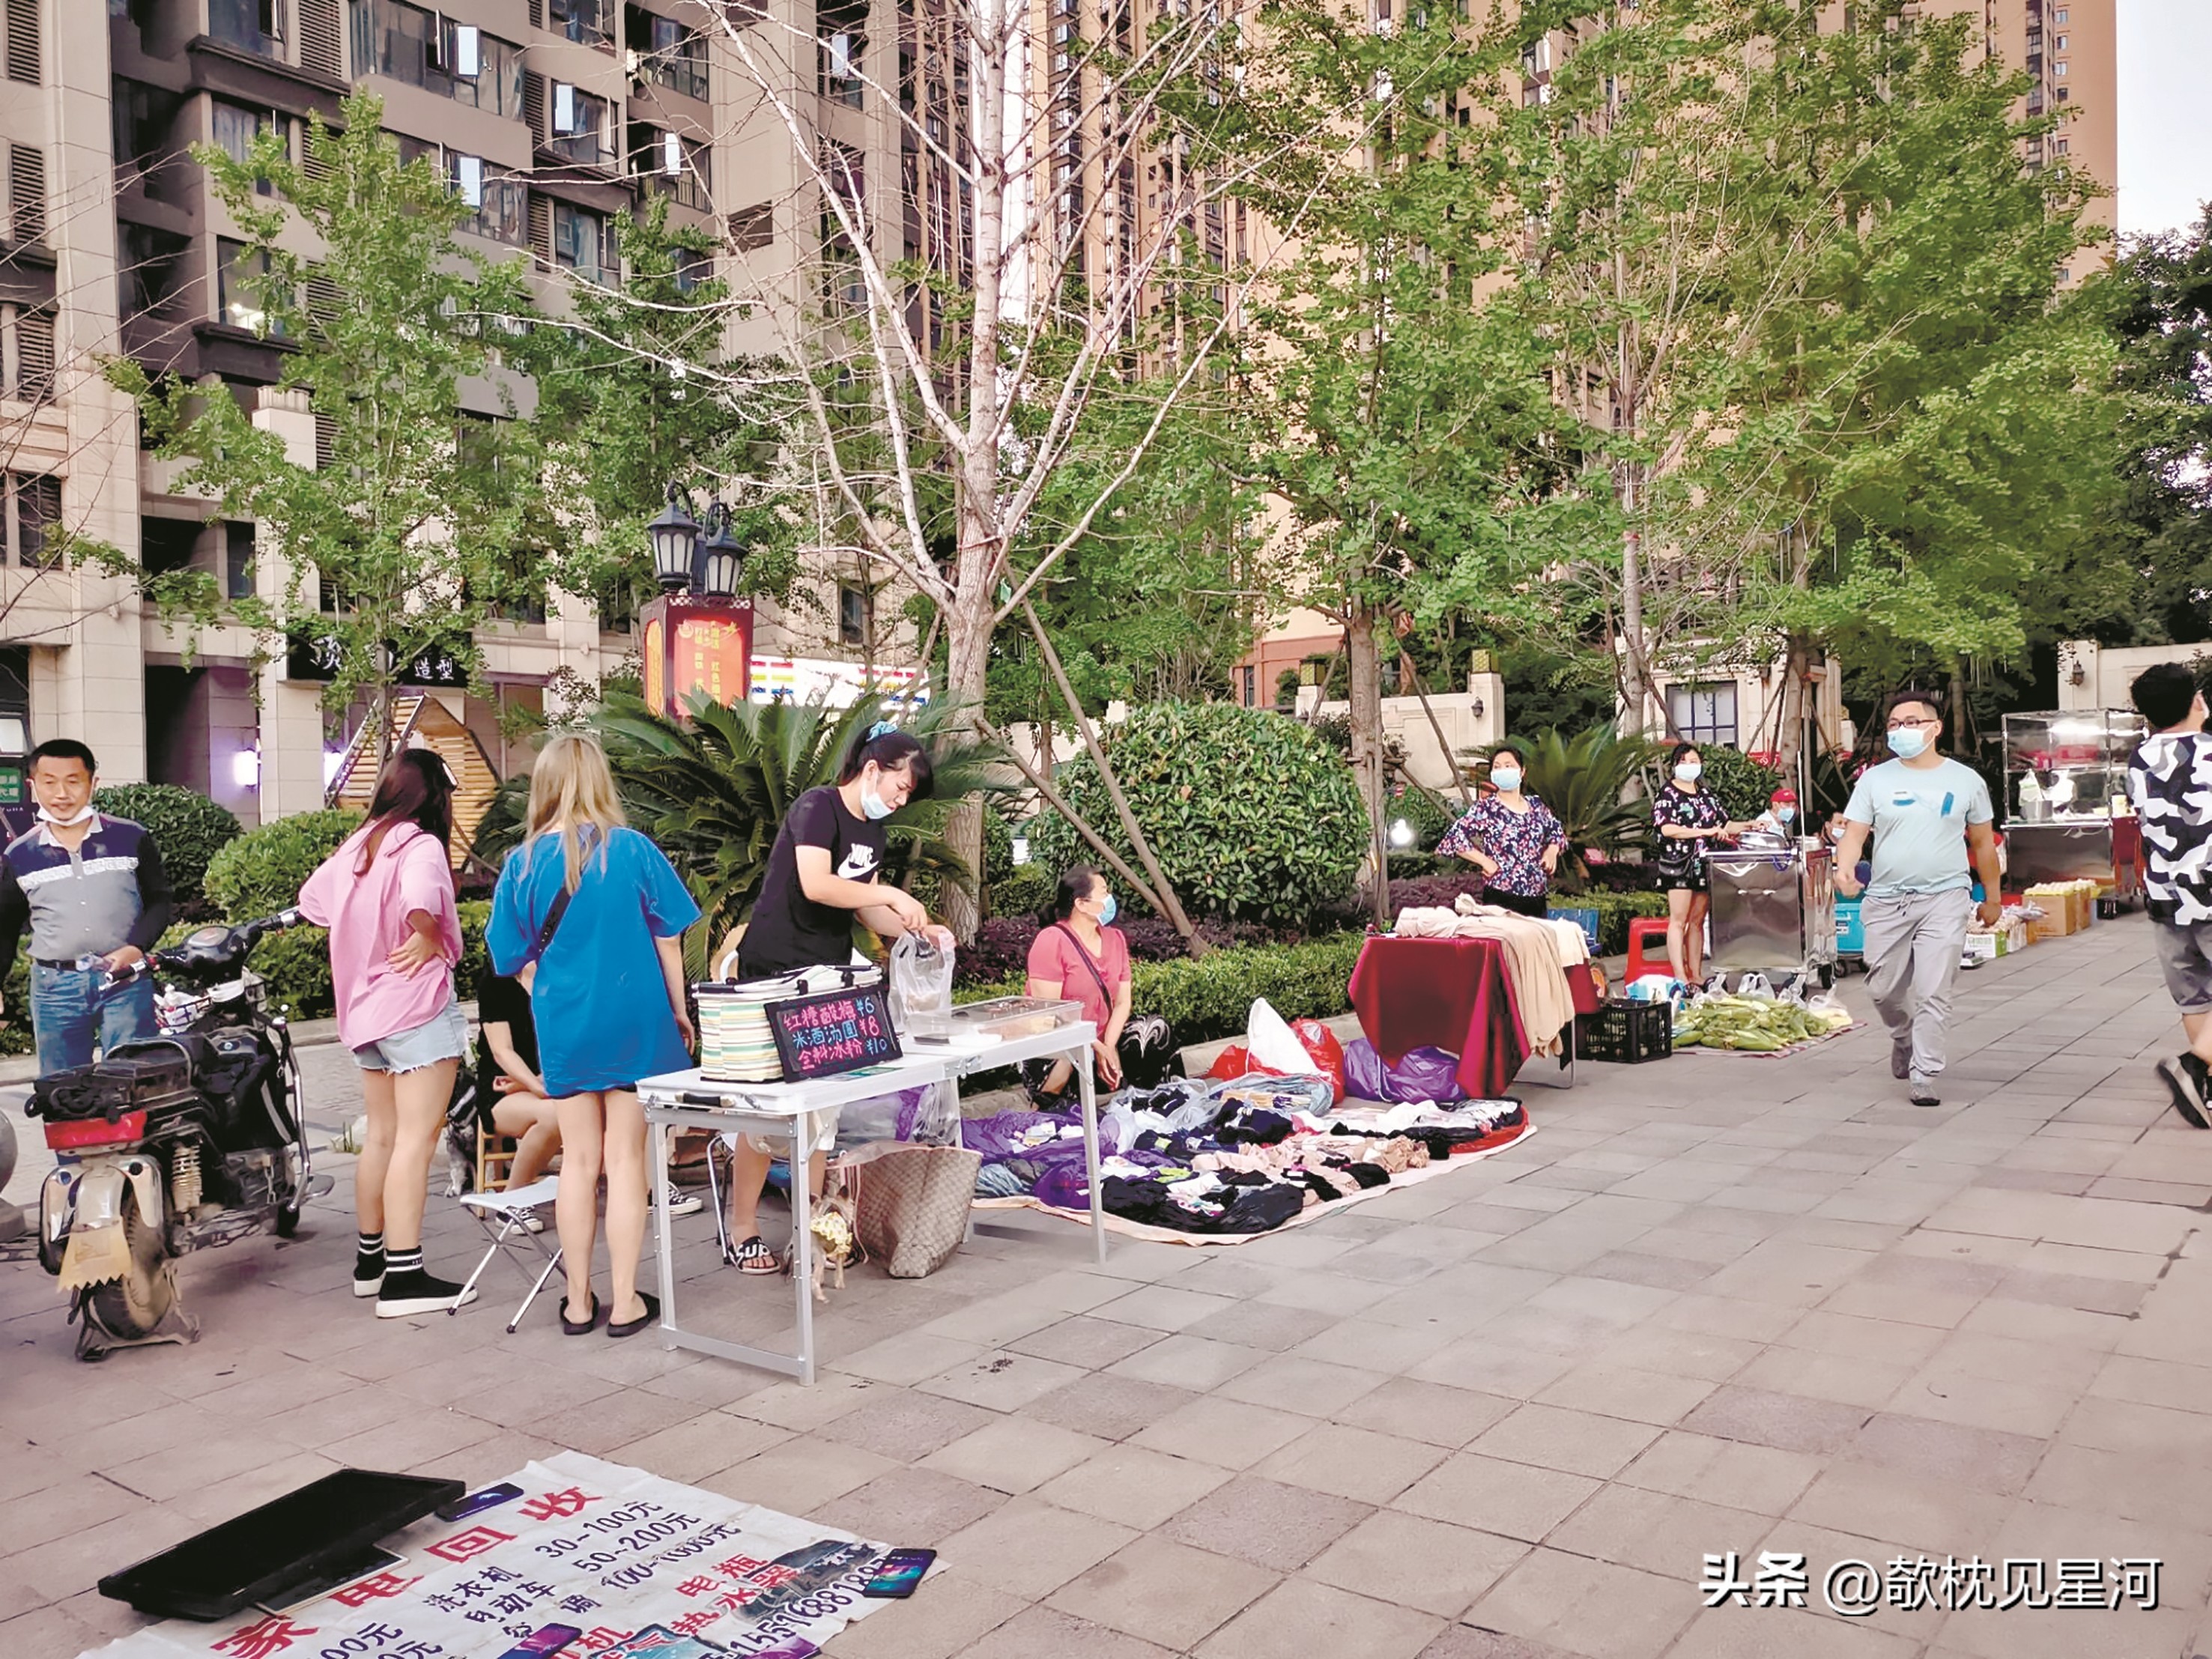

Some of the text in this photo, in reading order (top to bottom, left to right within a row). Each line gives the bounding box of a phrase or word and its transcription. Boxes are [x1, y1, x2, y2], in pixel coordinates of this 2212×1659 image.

[415, 657, 454, 680] 造型
[422, 1566, 523, 1612] 洗衣机
[676, 1553, 769, 1598] 电瓶
